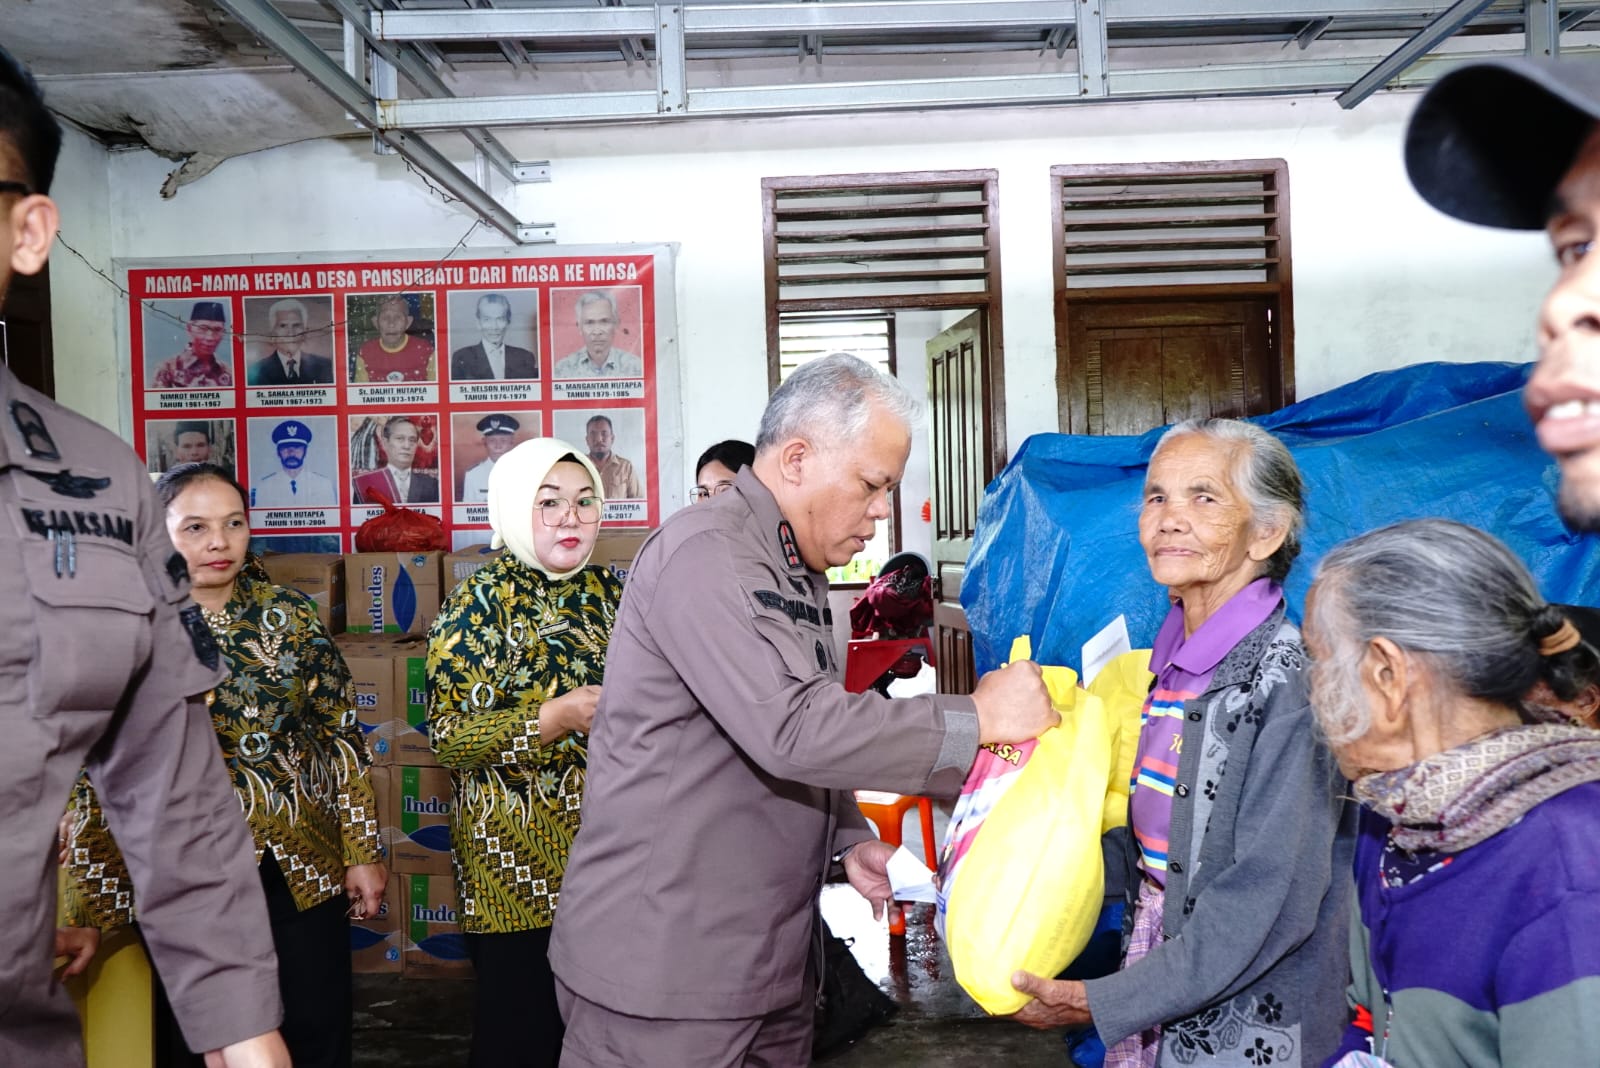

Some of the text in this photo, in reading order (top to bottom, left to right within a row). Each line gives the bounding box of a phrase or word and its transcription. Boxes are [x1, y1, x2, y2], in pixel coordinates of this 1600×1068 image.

[145, 263, 638, 293] NAMA-NAMA KEPALA DESA PANSURBATU DARI MASA KE MASA
[471, 385, 498, 393] NELSON
[499, 384, 532, 392] HUTAPEA
[611, 381, 642, 389] HUTAPEA
[296, 389, 327, 397] HUTAPEA
[396, 386, 427, 394] HUTAPEA
[189, 392, 221, 400] HUTAPEA
[387, 395, 425, 403] 1973-1974
[464, 393, 527, 401] TAHUN 1974-1979
[566, 391, 590, 399] TAHUN
[609, 504, 641, 512] HUTAPEA
[265, 510, 325, 519] JENNER HUTAPEA
[264, 519, 288, 527] TAHUN
